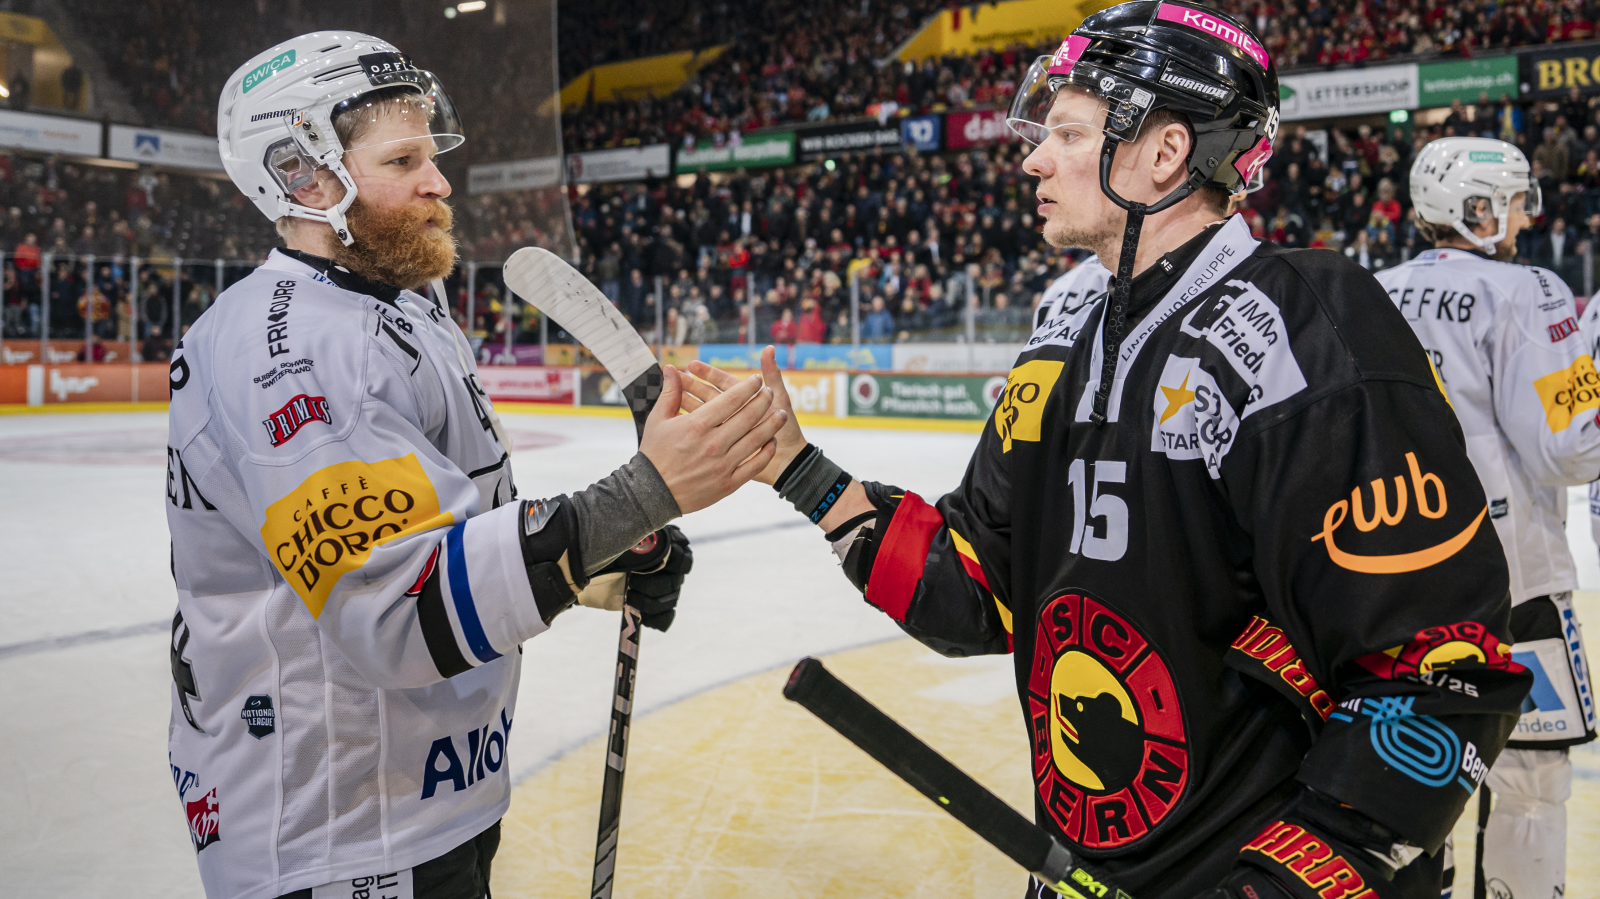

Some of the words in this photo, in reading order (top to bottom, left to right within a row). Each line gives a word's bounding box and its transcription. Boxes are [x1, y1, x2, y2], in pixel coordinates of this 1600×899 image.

[1183, 10, 1252, 50] Komit
[245, 54, 291, 88] SWICA
[1162, 74, 1229, 98] WARRIOR
[1306, 81, 1410, 99] LETTERSHOP
[1264, 106, 1280, 139] 15
[262, 366, 311, 389] SWITZERLAND
[1068, 458, 1129, 562] 15
[1311, 452, 1455, 545] ewb
[276, 489, 414, 571] CHICCO
[1407, 670, 1479, 698] 4/25
[242, 708, 275, 719] NATIONAL
[248, 717, 273, 727] LEAGUE
